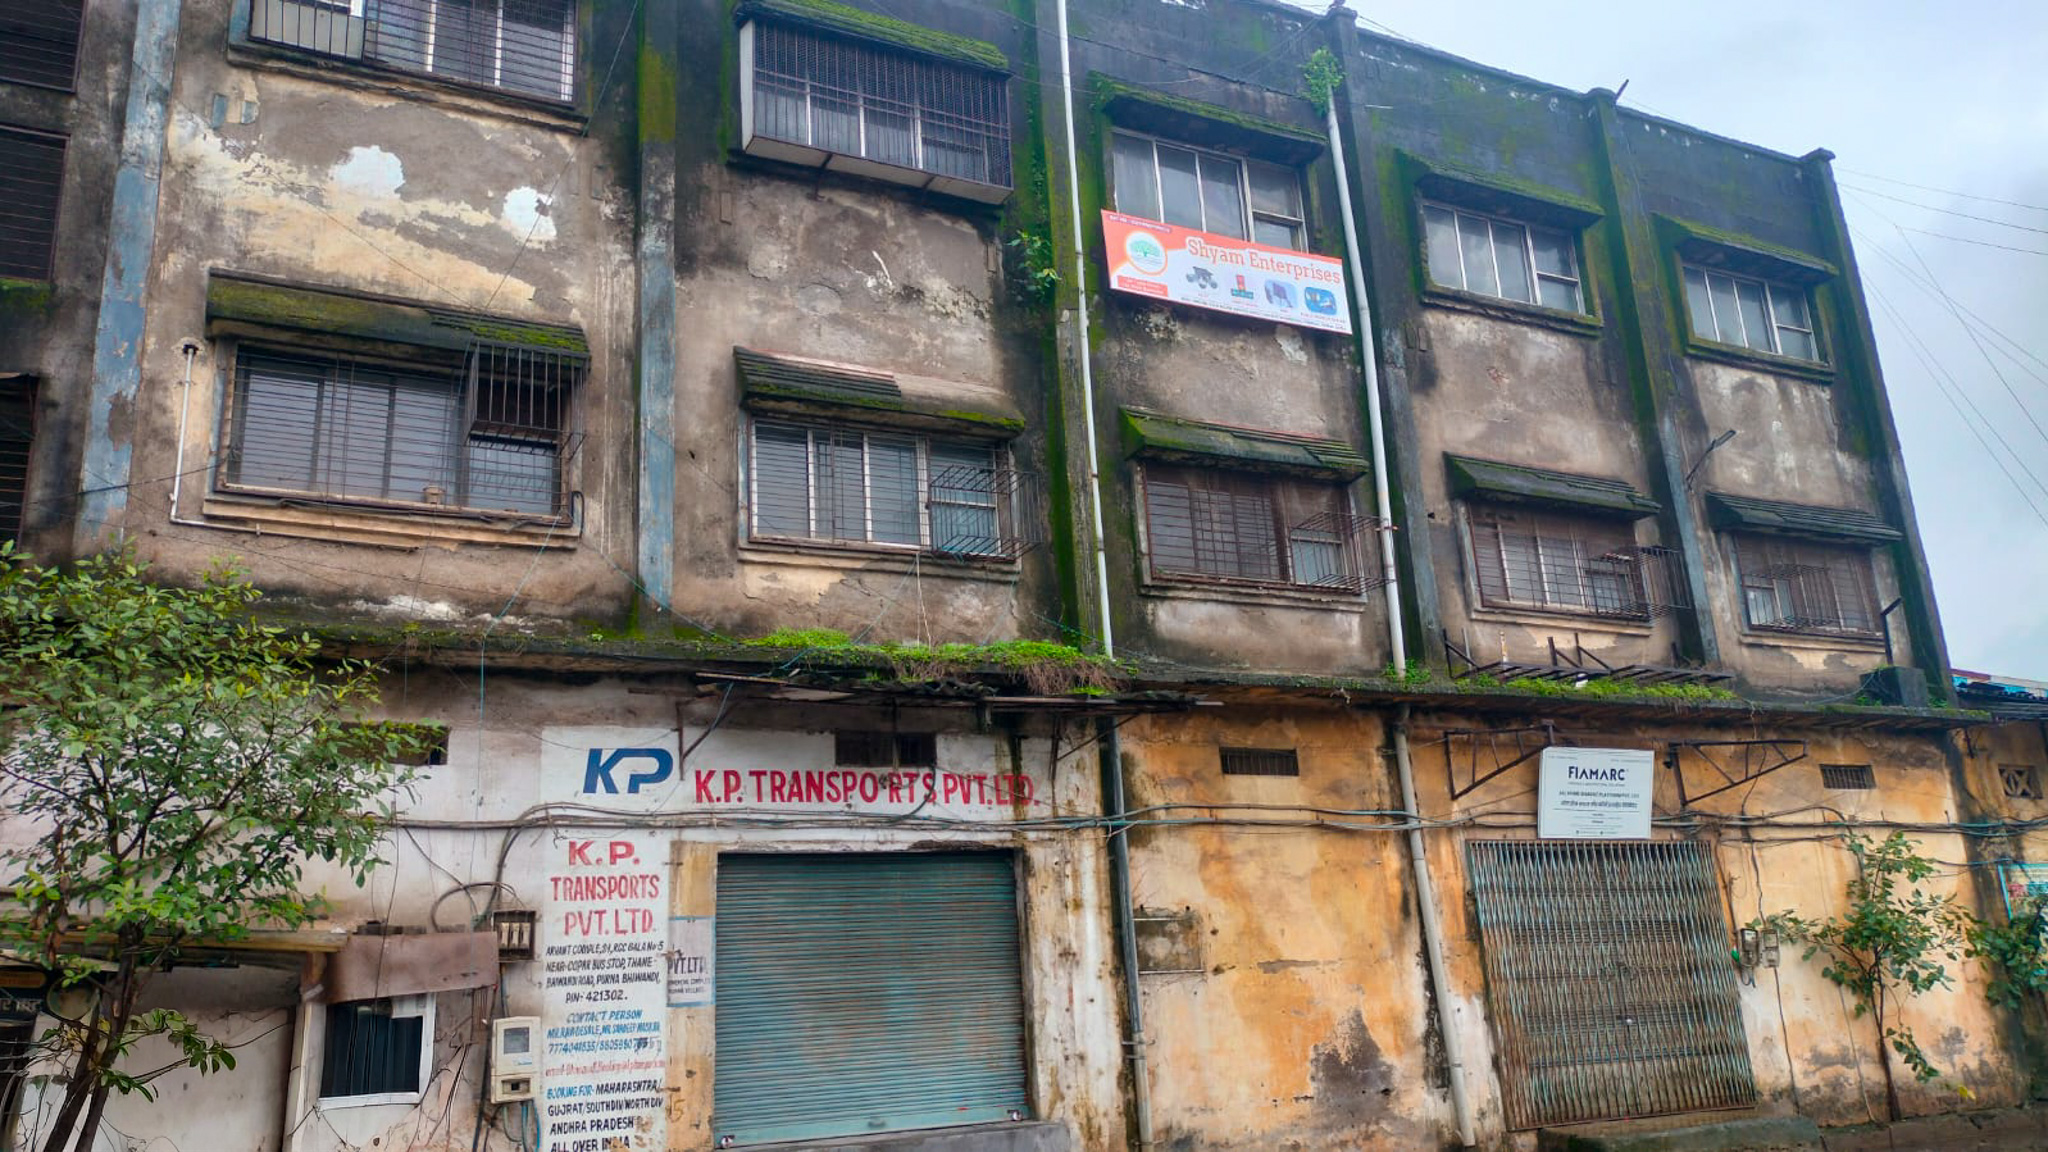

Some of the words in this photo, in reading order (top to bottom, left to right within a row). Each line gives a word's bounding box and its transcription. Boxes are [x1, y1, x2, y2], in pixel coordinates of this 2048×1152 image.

[1187, 236, 1245, 266] Shyam
[1249, 250, 1341, 284] Enterprises
[582, 747, 674, 795] KP
[1568, 765, 1626, 781] FIAMARC
[695, 769, 743, 804] K.P.
[748, 769, 938, 804] TRANSPORTS
[568, 840, 641, 866] K.P.
[550, 874, 660, 902] TRANSPORTS
[592, 959, 605, 970] BUS
[566, 1010, 608, 1024] CONTACT
[608, 1009, 643, 1021] PERSON
[550, 1121, 587, 1136] ANDHRA
[590, 1116, 635, 1132] PRADESH
[550, 1141, 570, 1152] ALL
[572, 1139, 599, 1152] OVER
